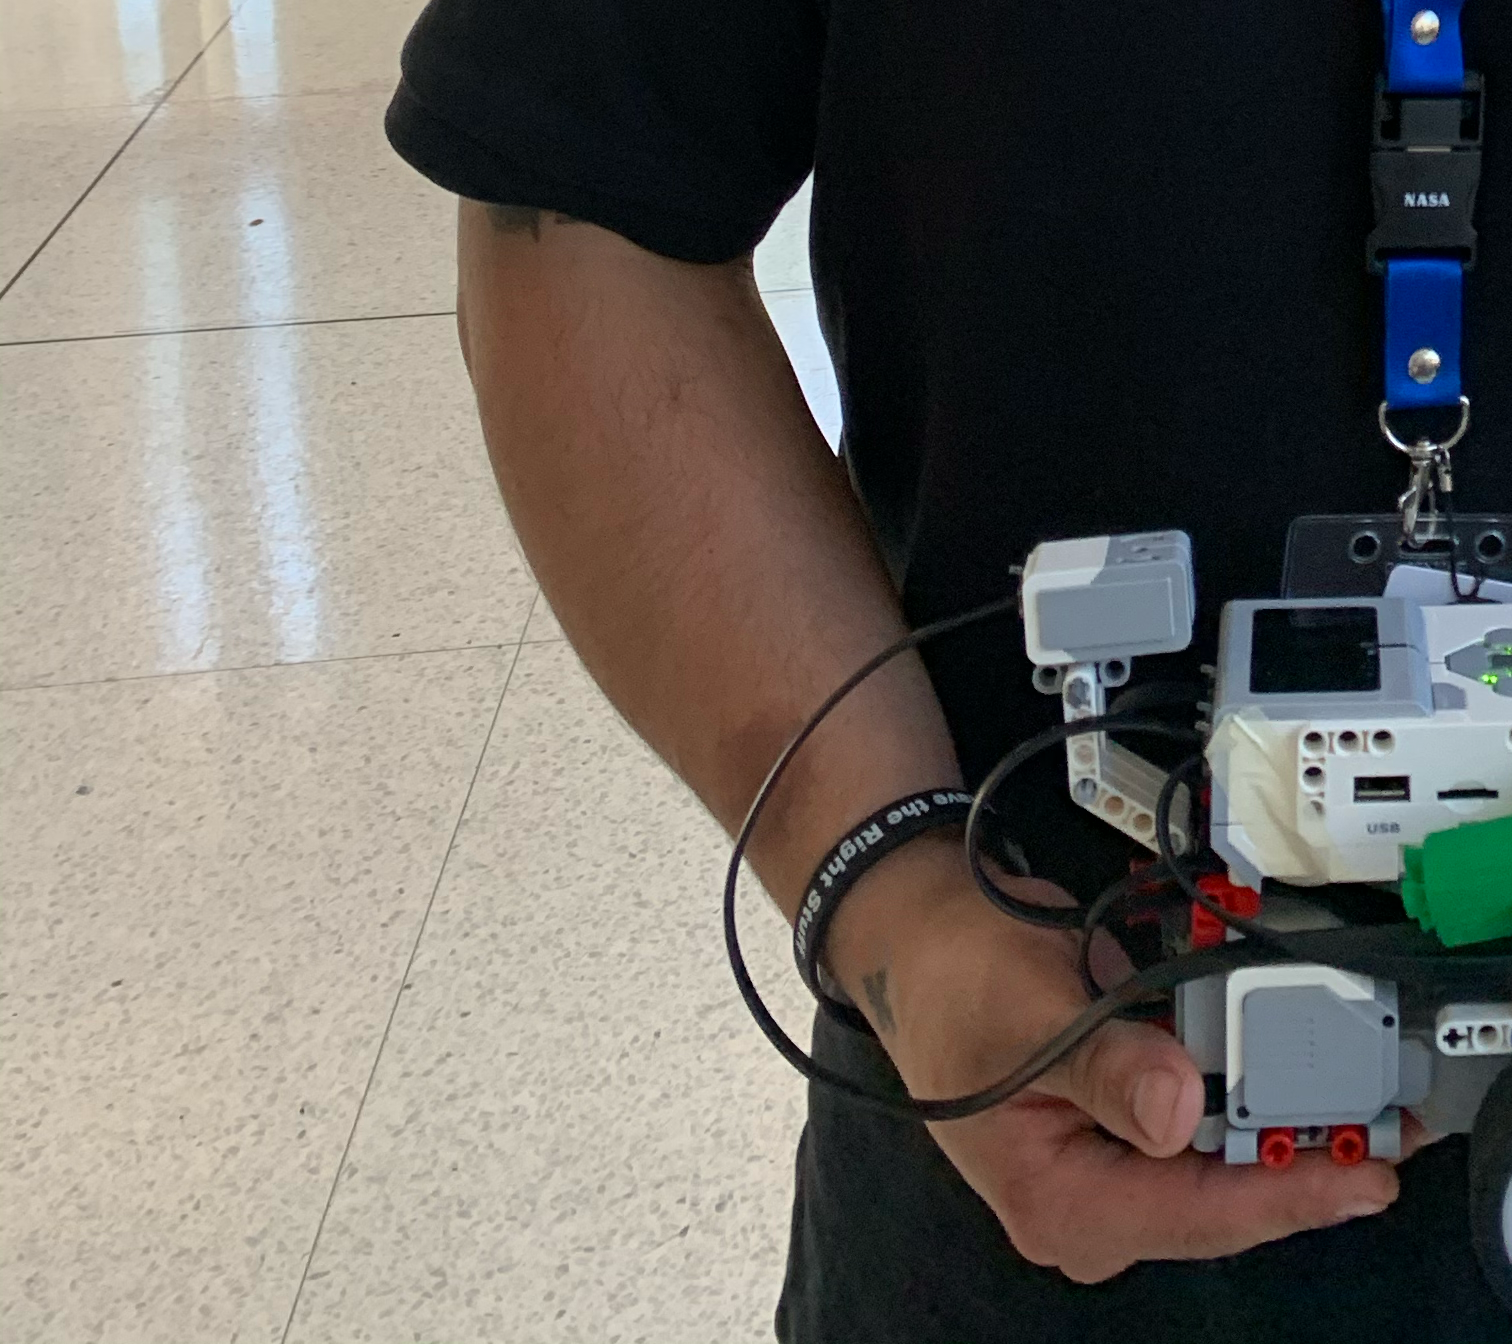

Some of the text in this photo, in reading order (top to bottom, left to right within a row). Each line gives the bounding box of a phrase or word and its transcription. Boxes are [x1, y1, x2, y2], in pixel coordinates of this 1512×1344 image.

[1404, 192, 1450, 207] NASA
[1367, 823, 1400, 834] USB
[795, 792, 976, 960] ave the Right Stuff
